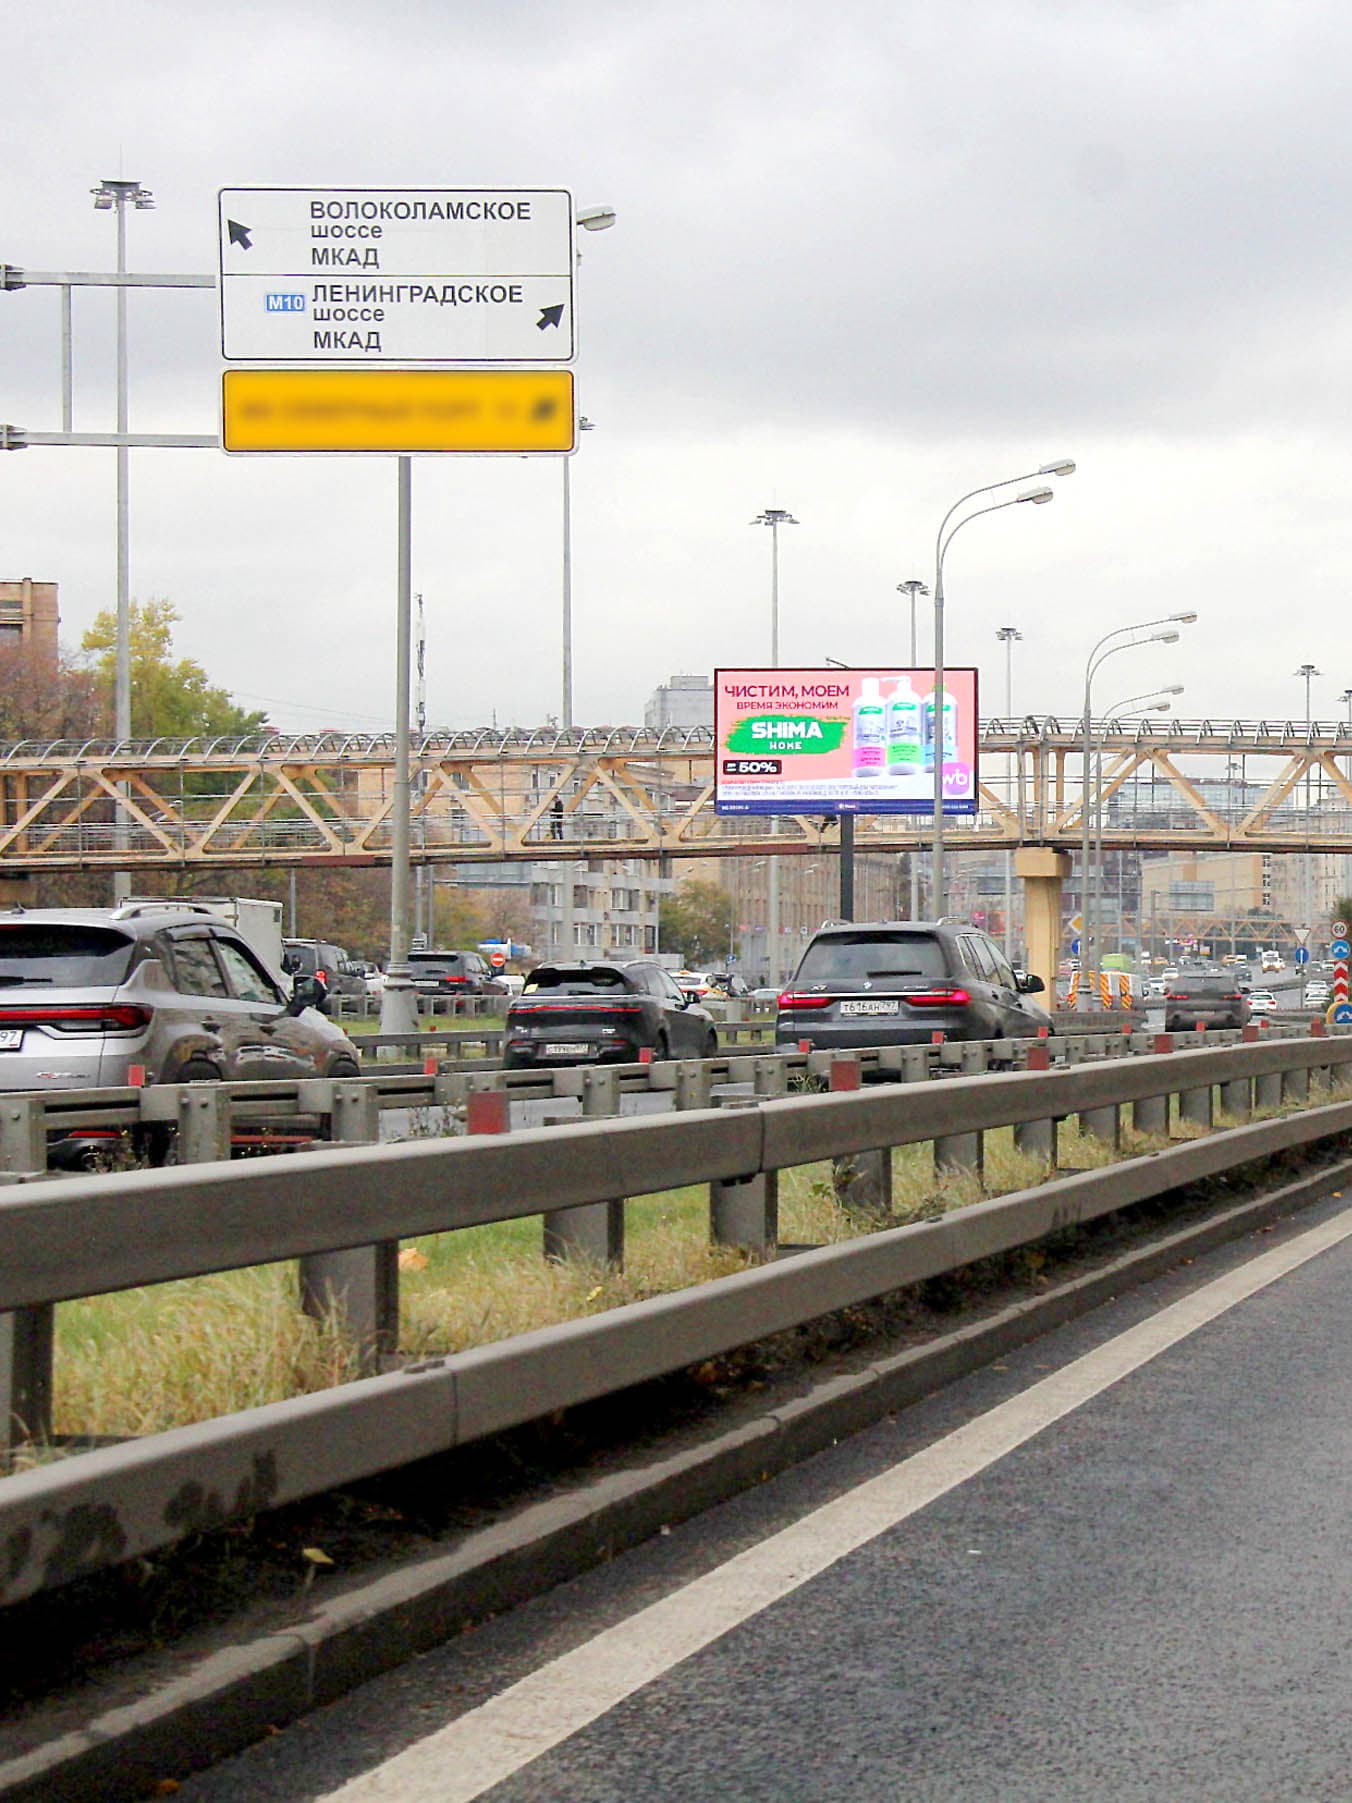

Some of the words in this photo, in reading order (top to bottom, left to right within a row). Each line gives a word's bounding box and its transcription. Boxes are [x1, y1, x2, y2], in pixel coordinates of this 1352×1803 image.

[311, 201, 531, 220] ВОЛОКОЛАМСКОЕ
[311, 223, 383, 239] шоссе
[311, 248, 380, 269] МКАД
[268, 295, 304, 311] М10
[312, 285, 523, 306] ЛЕНИНГРАДСКОЕ
[313, 307, 385, 322] шоссе
[313, 331, 382, 352] МКАД
[724, 685, 799, 699] ЧИСТИМ,
[801, 685, 850, 697] МОЕМ
[736, 702, 773, 710] ВРЕМЯ
[775, 701, 839, 710] ЭКОНОМИМ
[751, 721, 823, 739] SHIMA
[1334, 925, 1345, 934] 60
